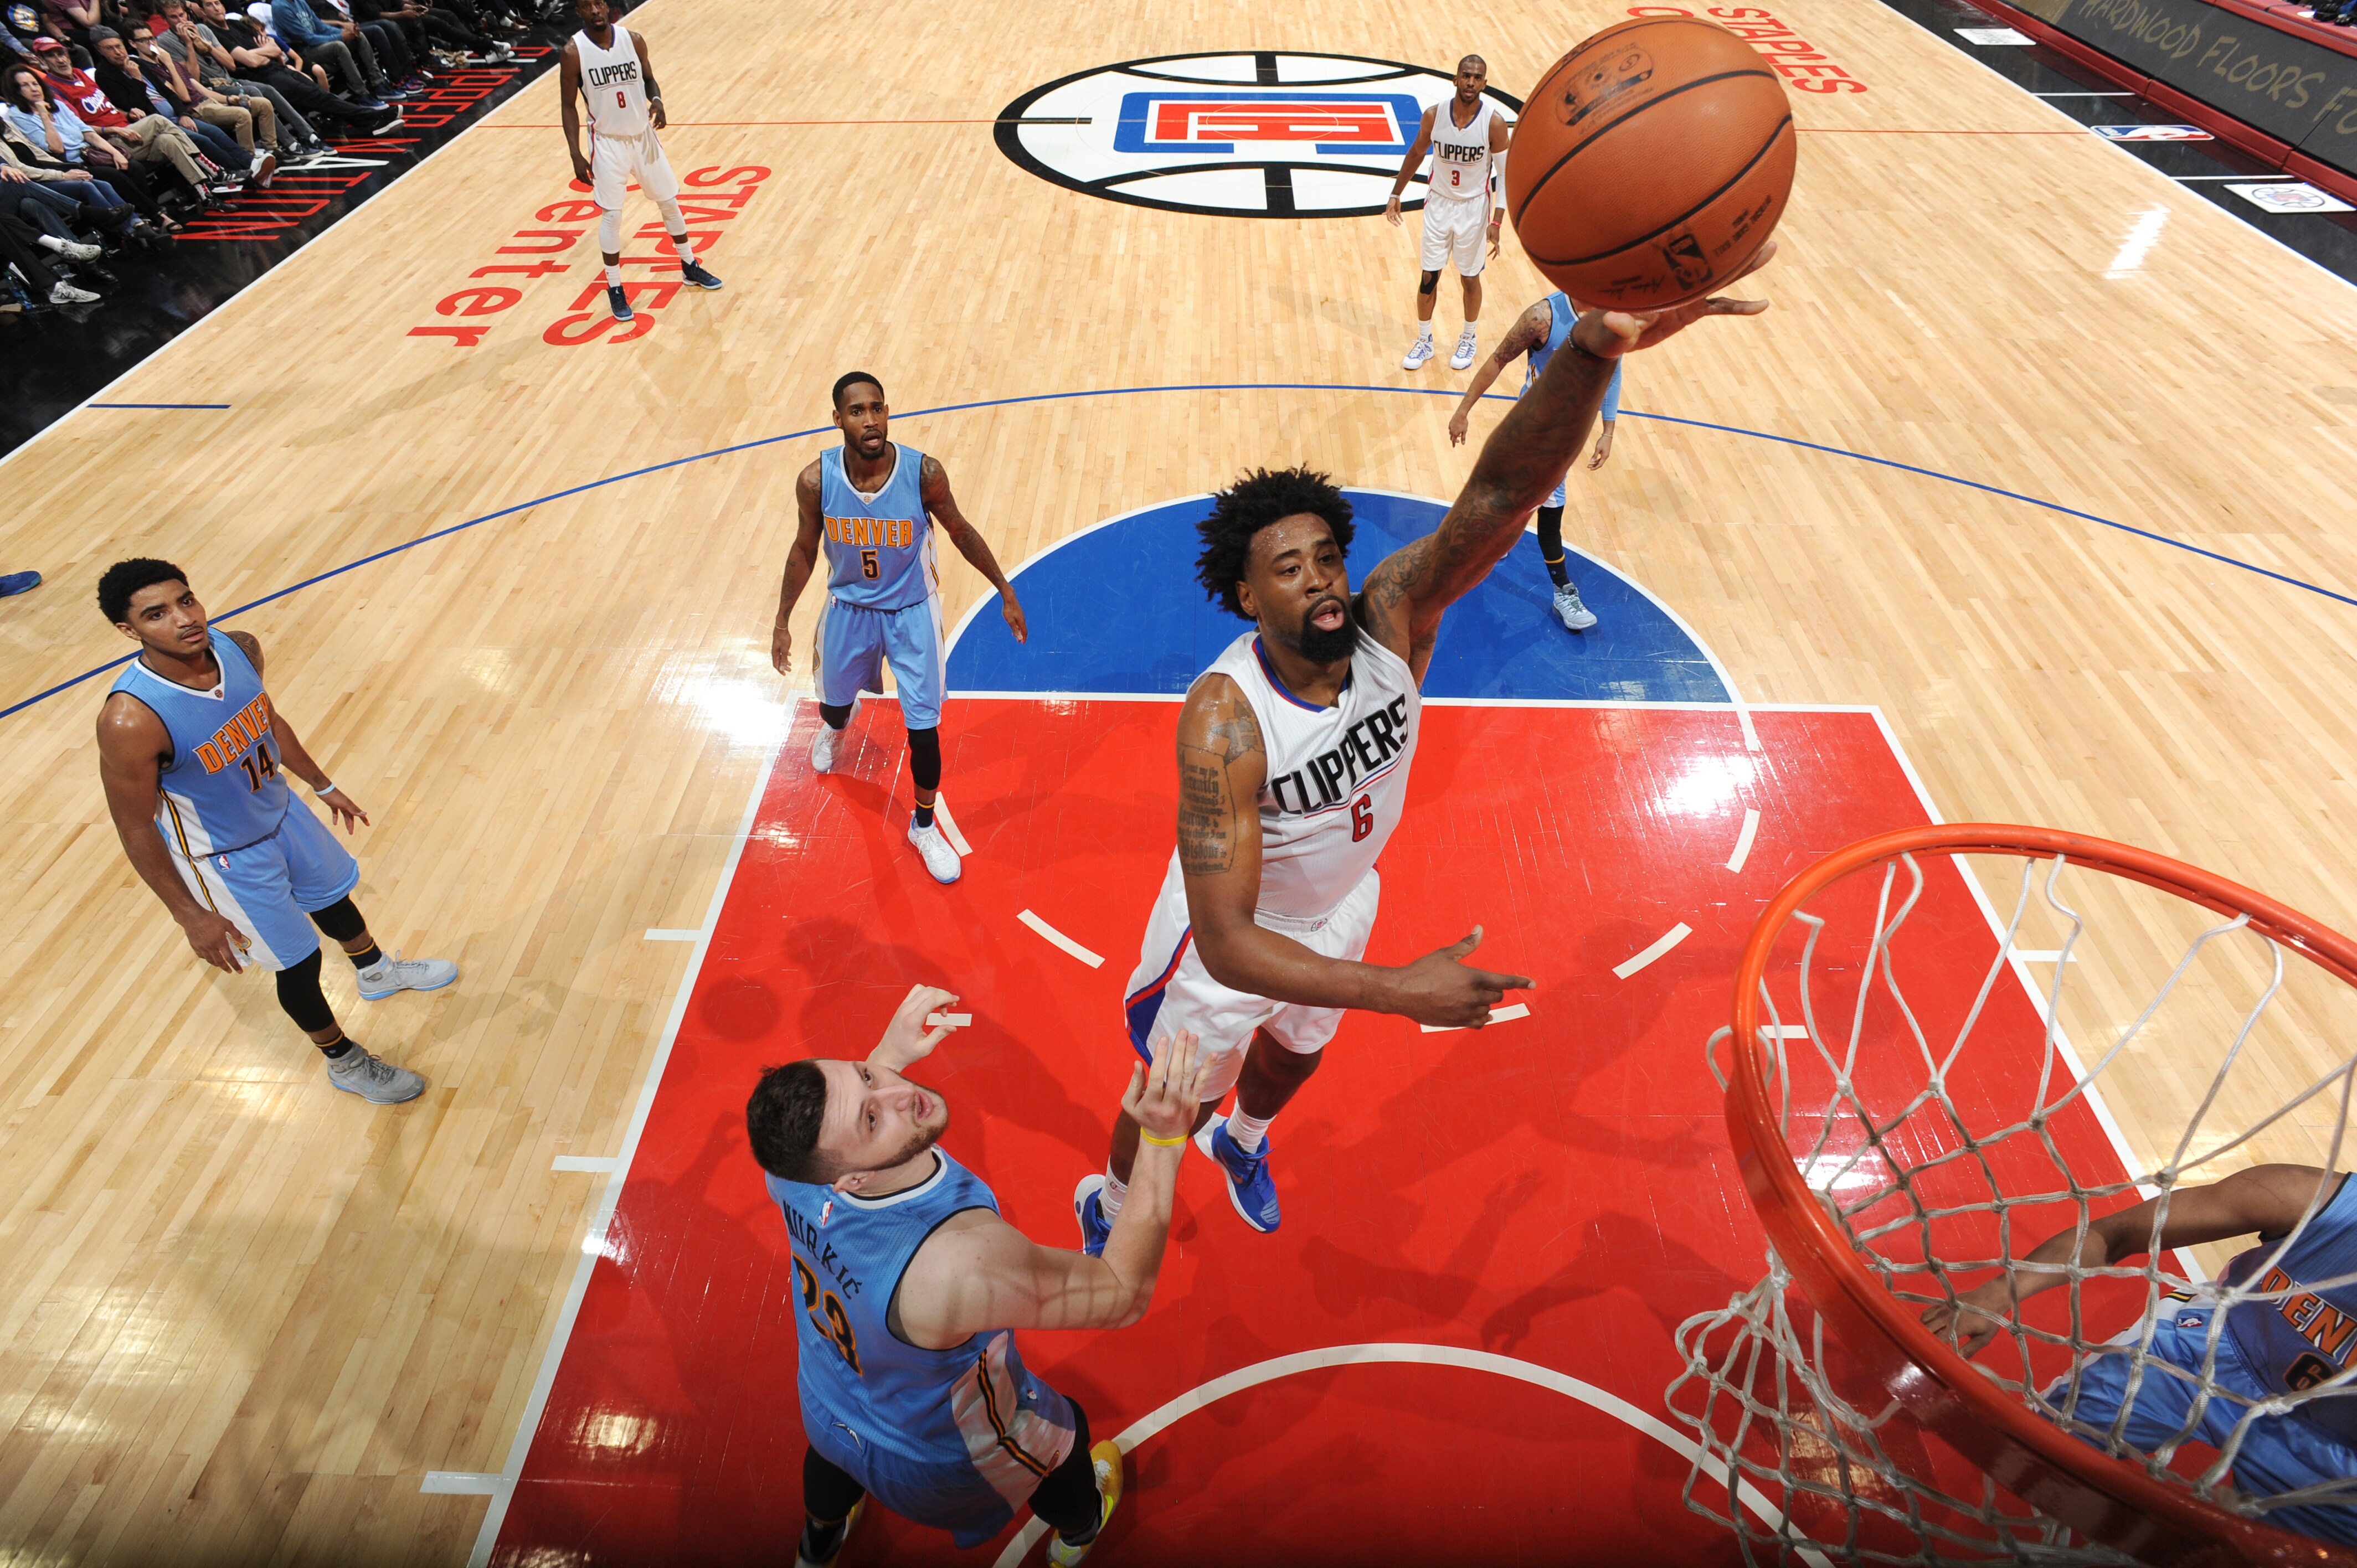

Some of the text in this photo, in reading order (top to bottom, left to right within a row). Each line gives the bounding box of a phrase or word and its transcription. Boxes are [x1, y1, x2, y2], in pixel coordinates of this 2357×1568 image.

[588, 61, 637, 86] CLIPPERS
[1707, 7, 1868, 94] STAPLES
[2078, 0, 2202, 59] HARDWOOD
[2196, 35, 2326, 109] FLOORS
[616, 91, 626, 109] 8
[1433, 140, 1485, 162] CLIPPERS
[171, 138, 421, 240] NATION
[1451, 170, 1460, 186] 3
[543, 166, 771, 346] STAPLES
[823, 514, 913, 548] DENVER
[860, 549, 881, 580] 5
[192, 691, 270, 775] DENVER
[1270, 693, 1409, 815] CLIPPERS
[239, 741, 276, 793] 14
[1350, 793, 1373, 843] 6
[783, 1200, 863, 1300] NURKIĆ
